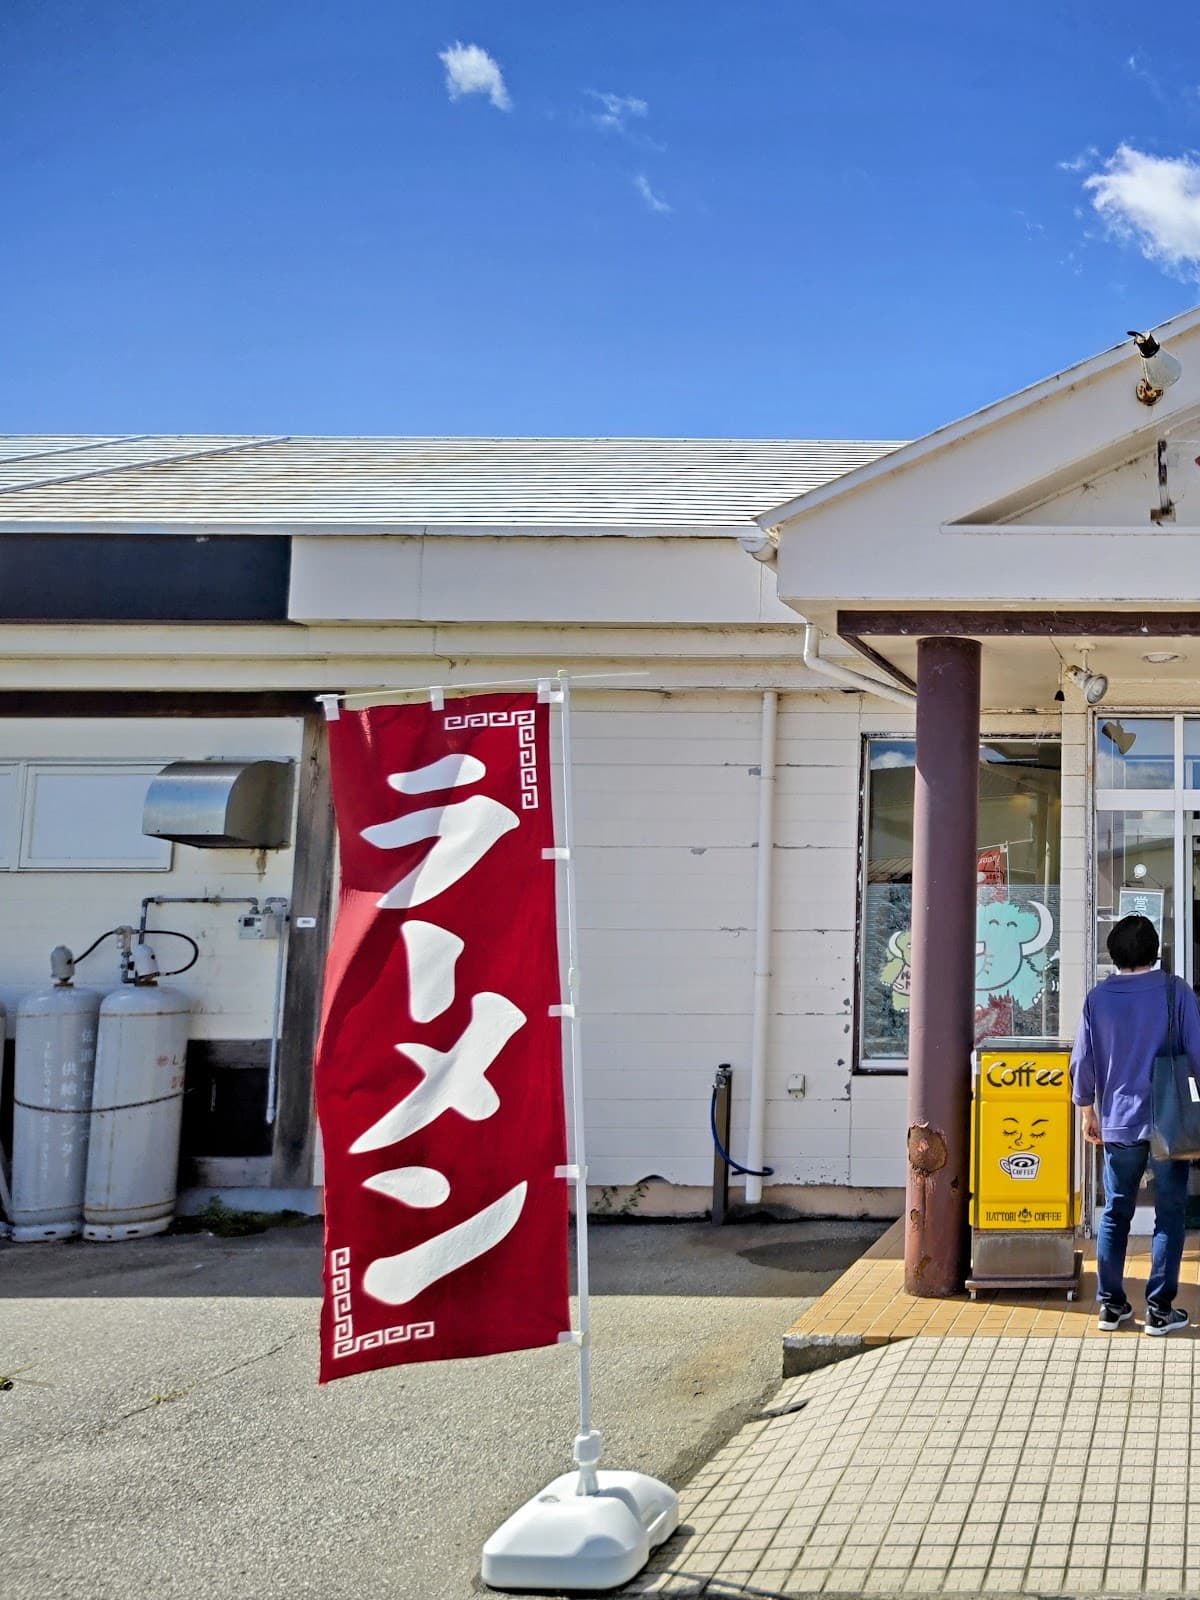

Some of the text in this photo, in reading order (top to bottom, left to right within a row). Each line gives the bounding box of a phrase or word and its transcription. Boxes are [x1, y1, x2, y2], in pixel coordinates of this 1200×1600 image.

[349, 753, 528, 1305] ラーメン
[986, 1061, 1065, 1088] Coffee
[1012, 1168, 1035, 1176] COFFEE
[986, 1211, 1062, 1221] HATTORI COFFEE
